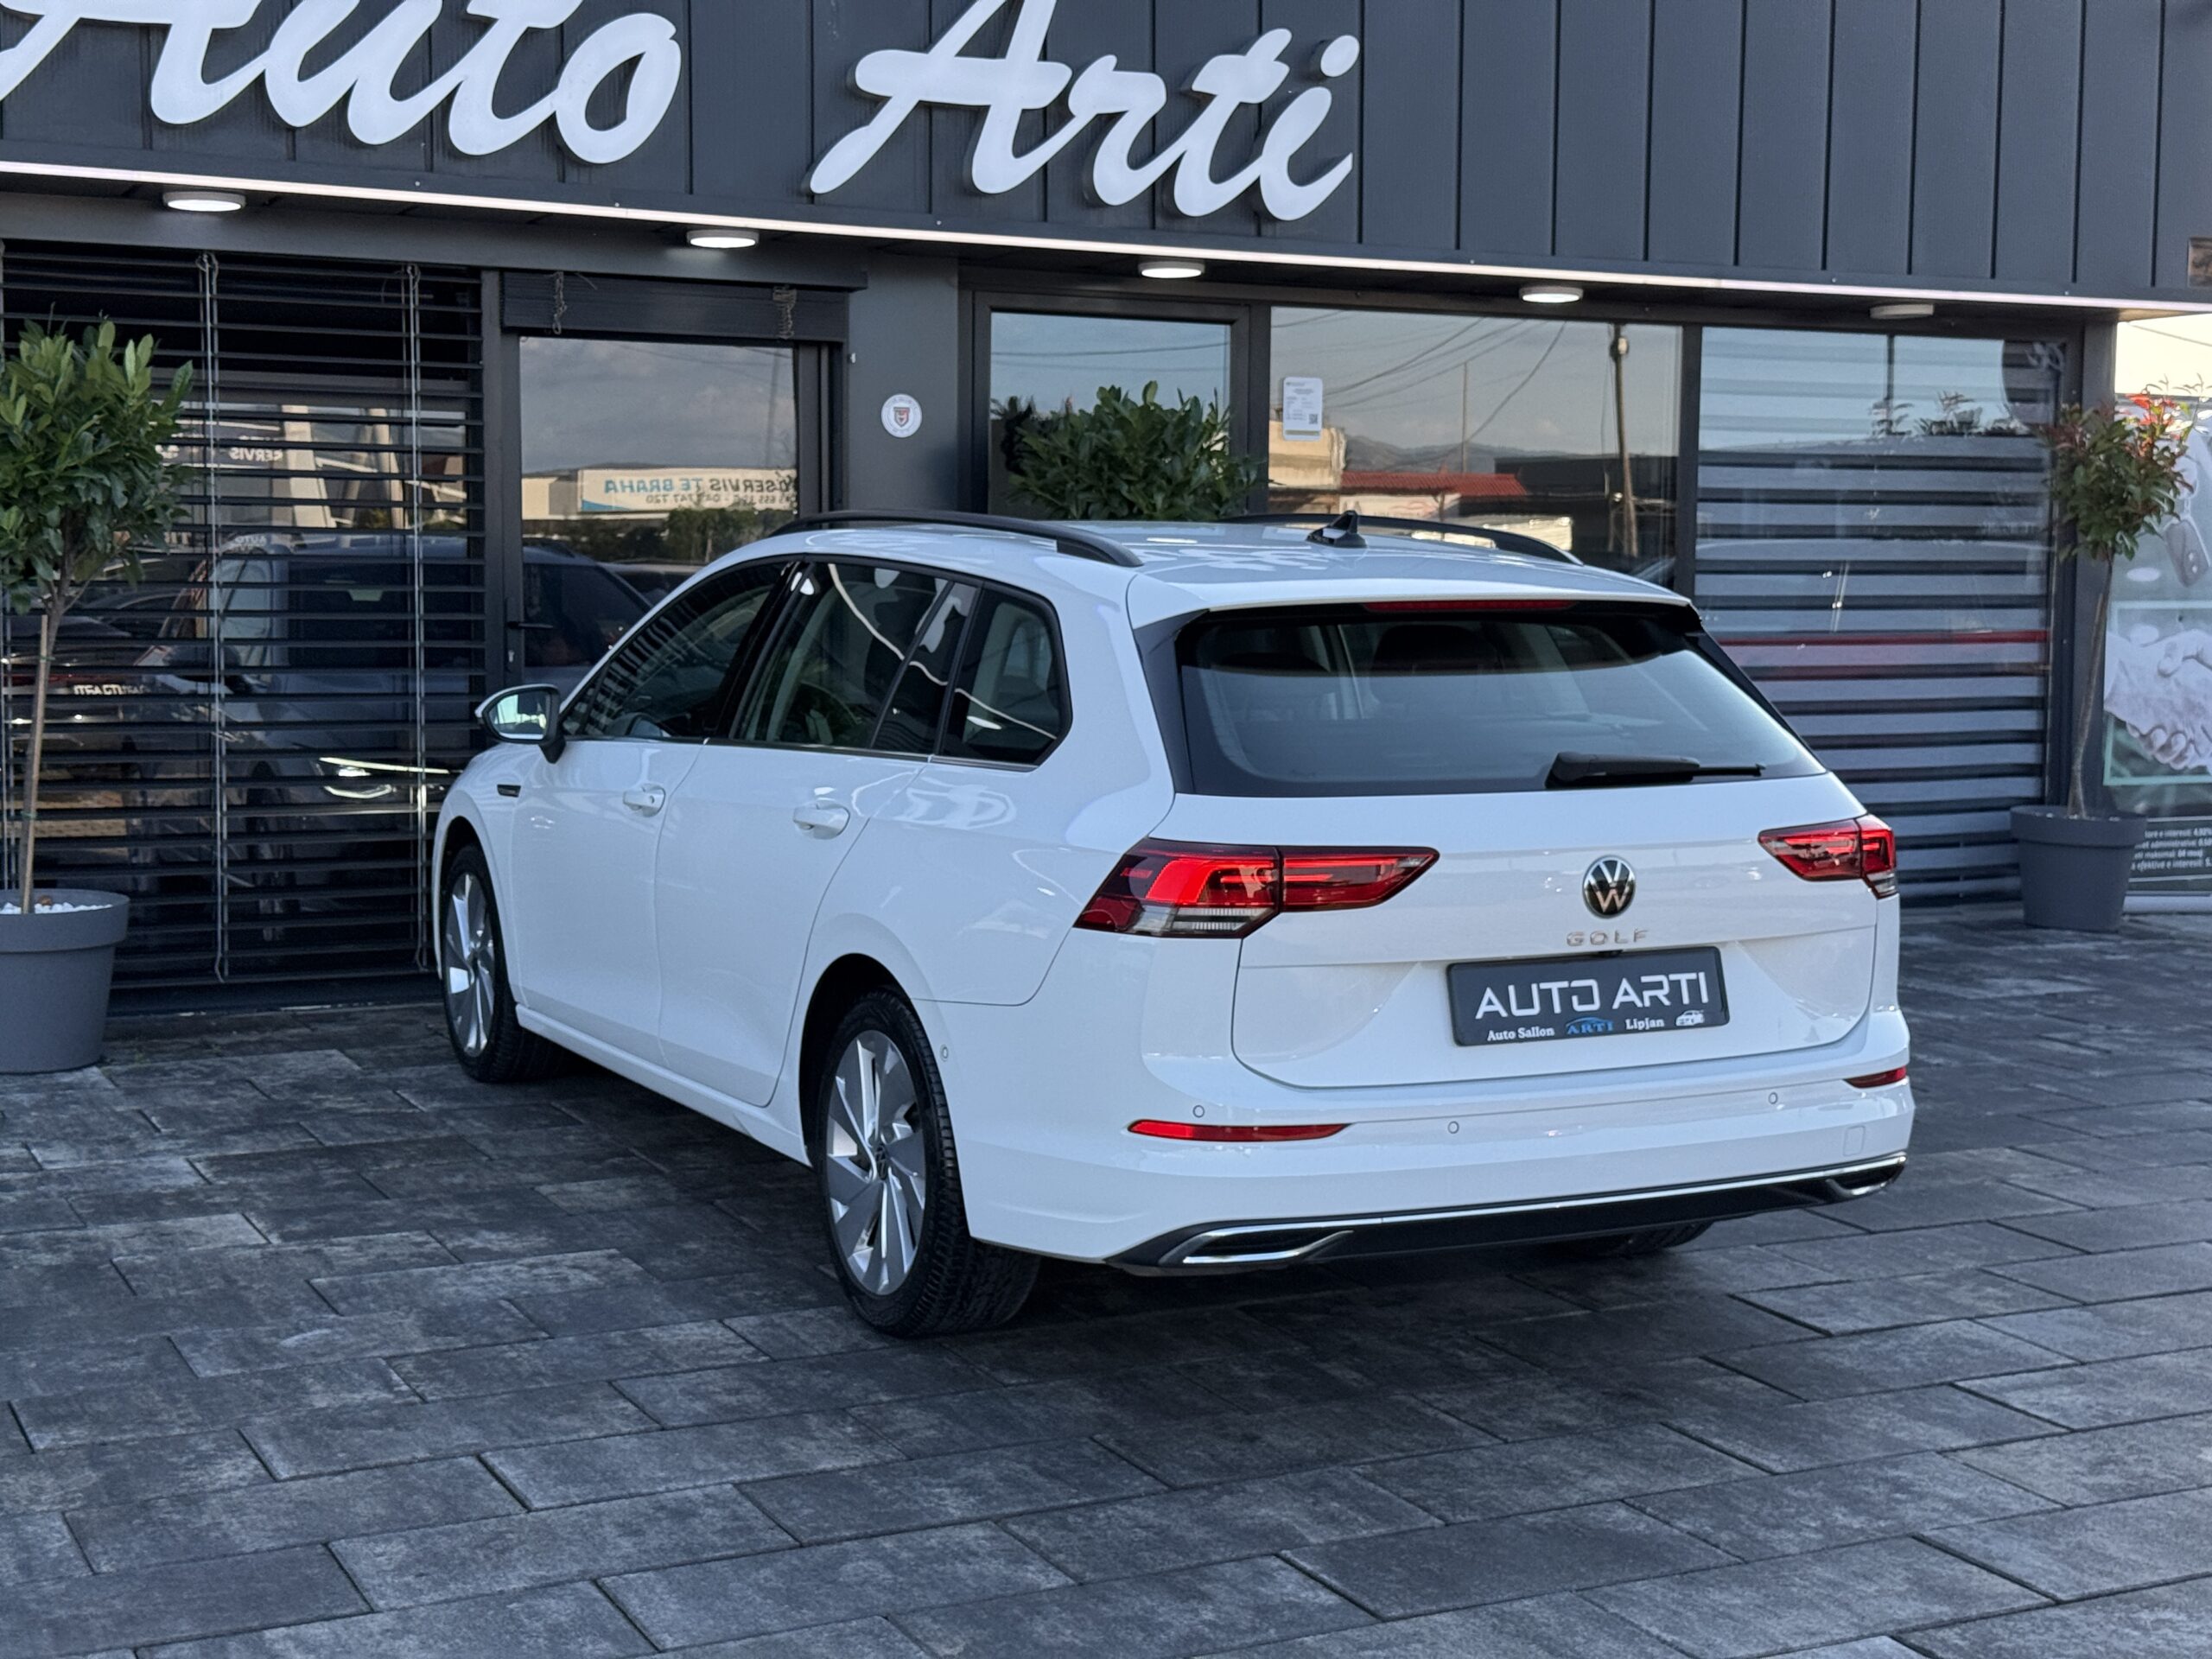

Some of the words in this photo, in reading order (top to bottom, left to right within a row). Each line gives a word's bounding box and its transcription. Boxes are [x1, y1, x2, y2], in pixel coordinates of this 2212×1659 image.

[810, 0, 1360, 221] Arti
[1566, 928, 1649, 947] GOLF
[1475, 979, 1600, 1020] AUTO
[1611, 972, 1710, 1010] ARTI
[1487, 1028, 1516, 1041] Auto
[1567, 1019, 1614, 1035] ARTI
[1624, 1017, 1665, 1031] Lipjan
